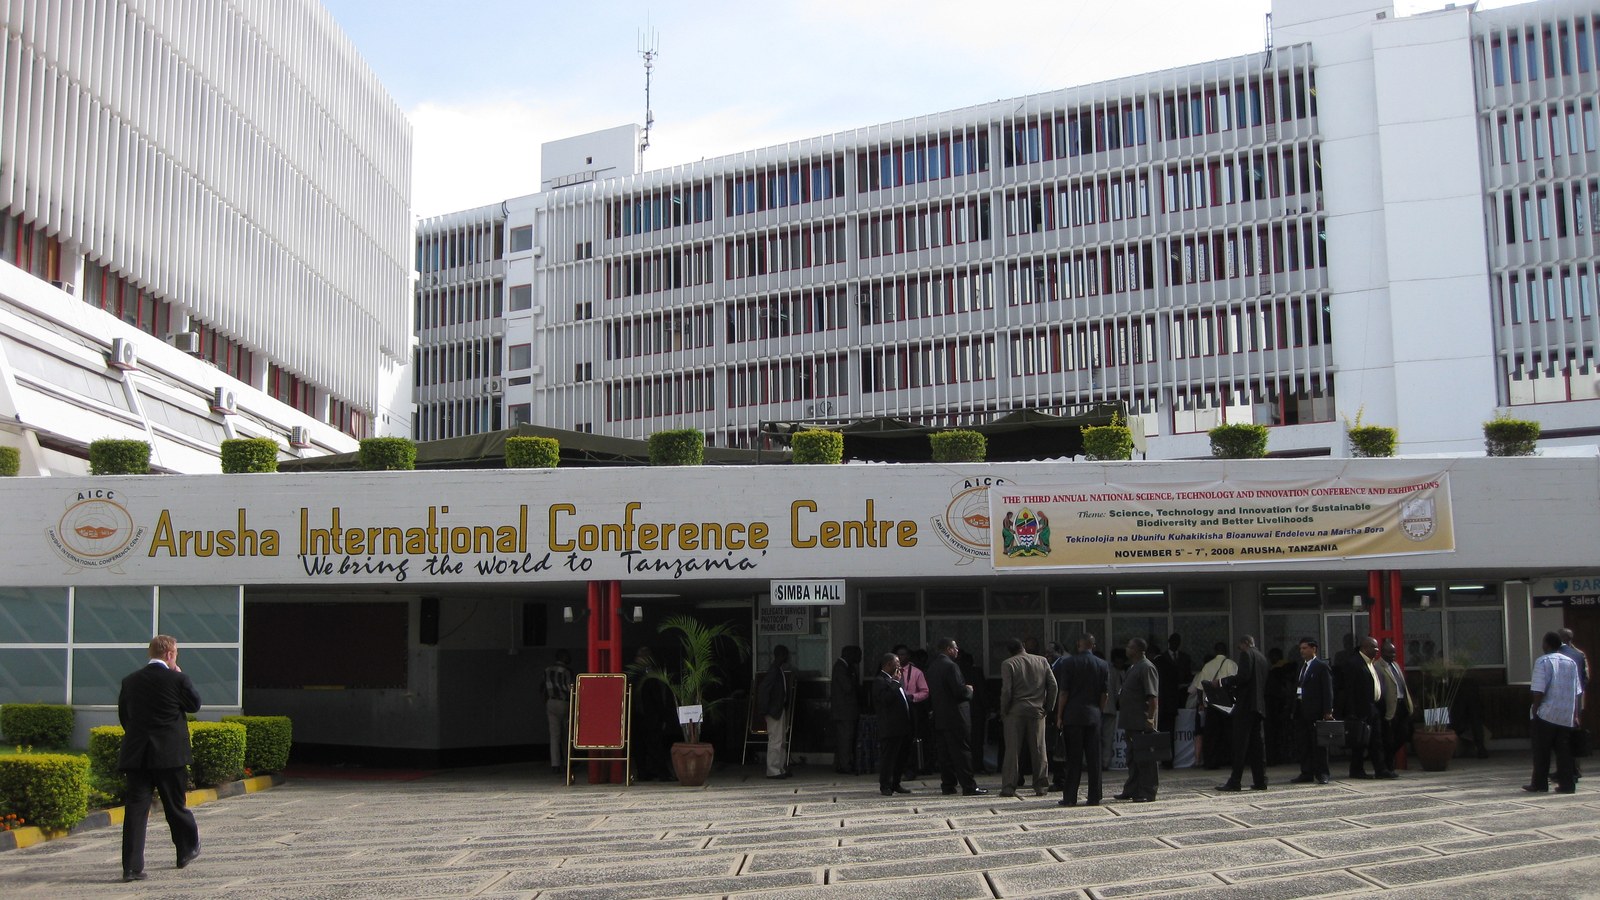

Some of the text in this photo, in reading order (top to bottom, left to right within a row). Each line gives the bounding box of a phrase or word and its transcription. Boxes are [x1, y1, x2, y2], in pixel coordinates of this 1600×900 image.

[77, 490, 114, 500] AICC
[1002, 480, 1440, 504] THE THIRD ANNUAL NATIONAL SCIENCE, TECHNOLOGY AND INNOVATION CONFERENCE AND EXHIBITIONS
[1077, 503, 1371, 518] Theme: Science, Technology and Innovation for Sustainable
[148, 498, 918, 558] Arusha International Conference Centre
[1136, 516, 1314, 528] Biodiversity and Better Livelihoods
[935, 518, 990, 556] ARUSHA INTERNATIONAL
[1066, 534, 1115, 544] Tekinolojia
[1132, 533, 1166, 542] Ubunifu
[1168, 532, 1224, 540] Kuhakikisha
[1226, 530, 1272, 540] Bioanuwai
[1275, 529, 1315, 538] Endelevu
[1330, 528, 1362, 536] Maisha
[1364, 526, 1384, 534] Bora
[49, 528, 144, 566] ARUSHA INTERNATIONAL CONFERENCE CENTRE
[1114, 550, 1172, 558] NOVEMBER
[1210, 548, 1234, 556] 2008
[1240, 546, 1285, 554] ARUSHA,
[1288, 544, 1338, 553] TANZANIA
[337, 555, 410, 582] bring
[422, 554, 464, 576] the
[564, 552, 592, 572] to
[777, 584, 840, 600] SIMBA HALL
[1570, 596, 1596, 606] Sales
[761, 608, 783, 616] DELEGATE
